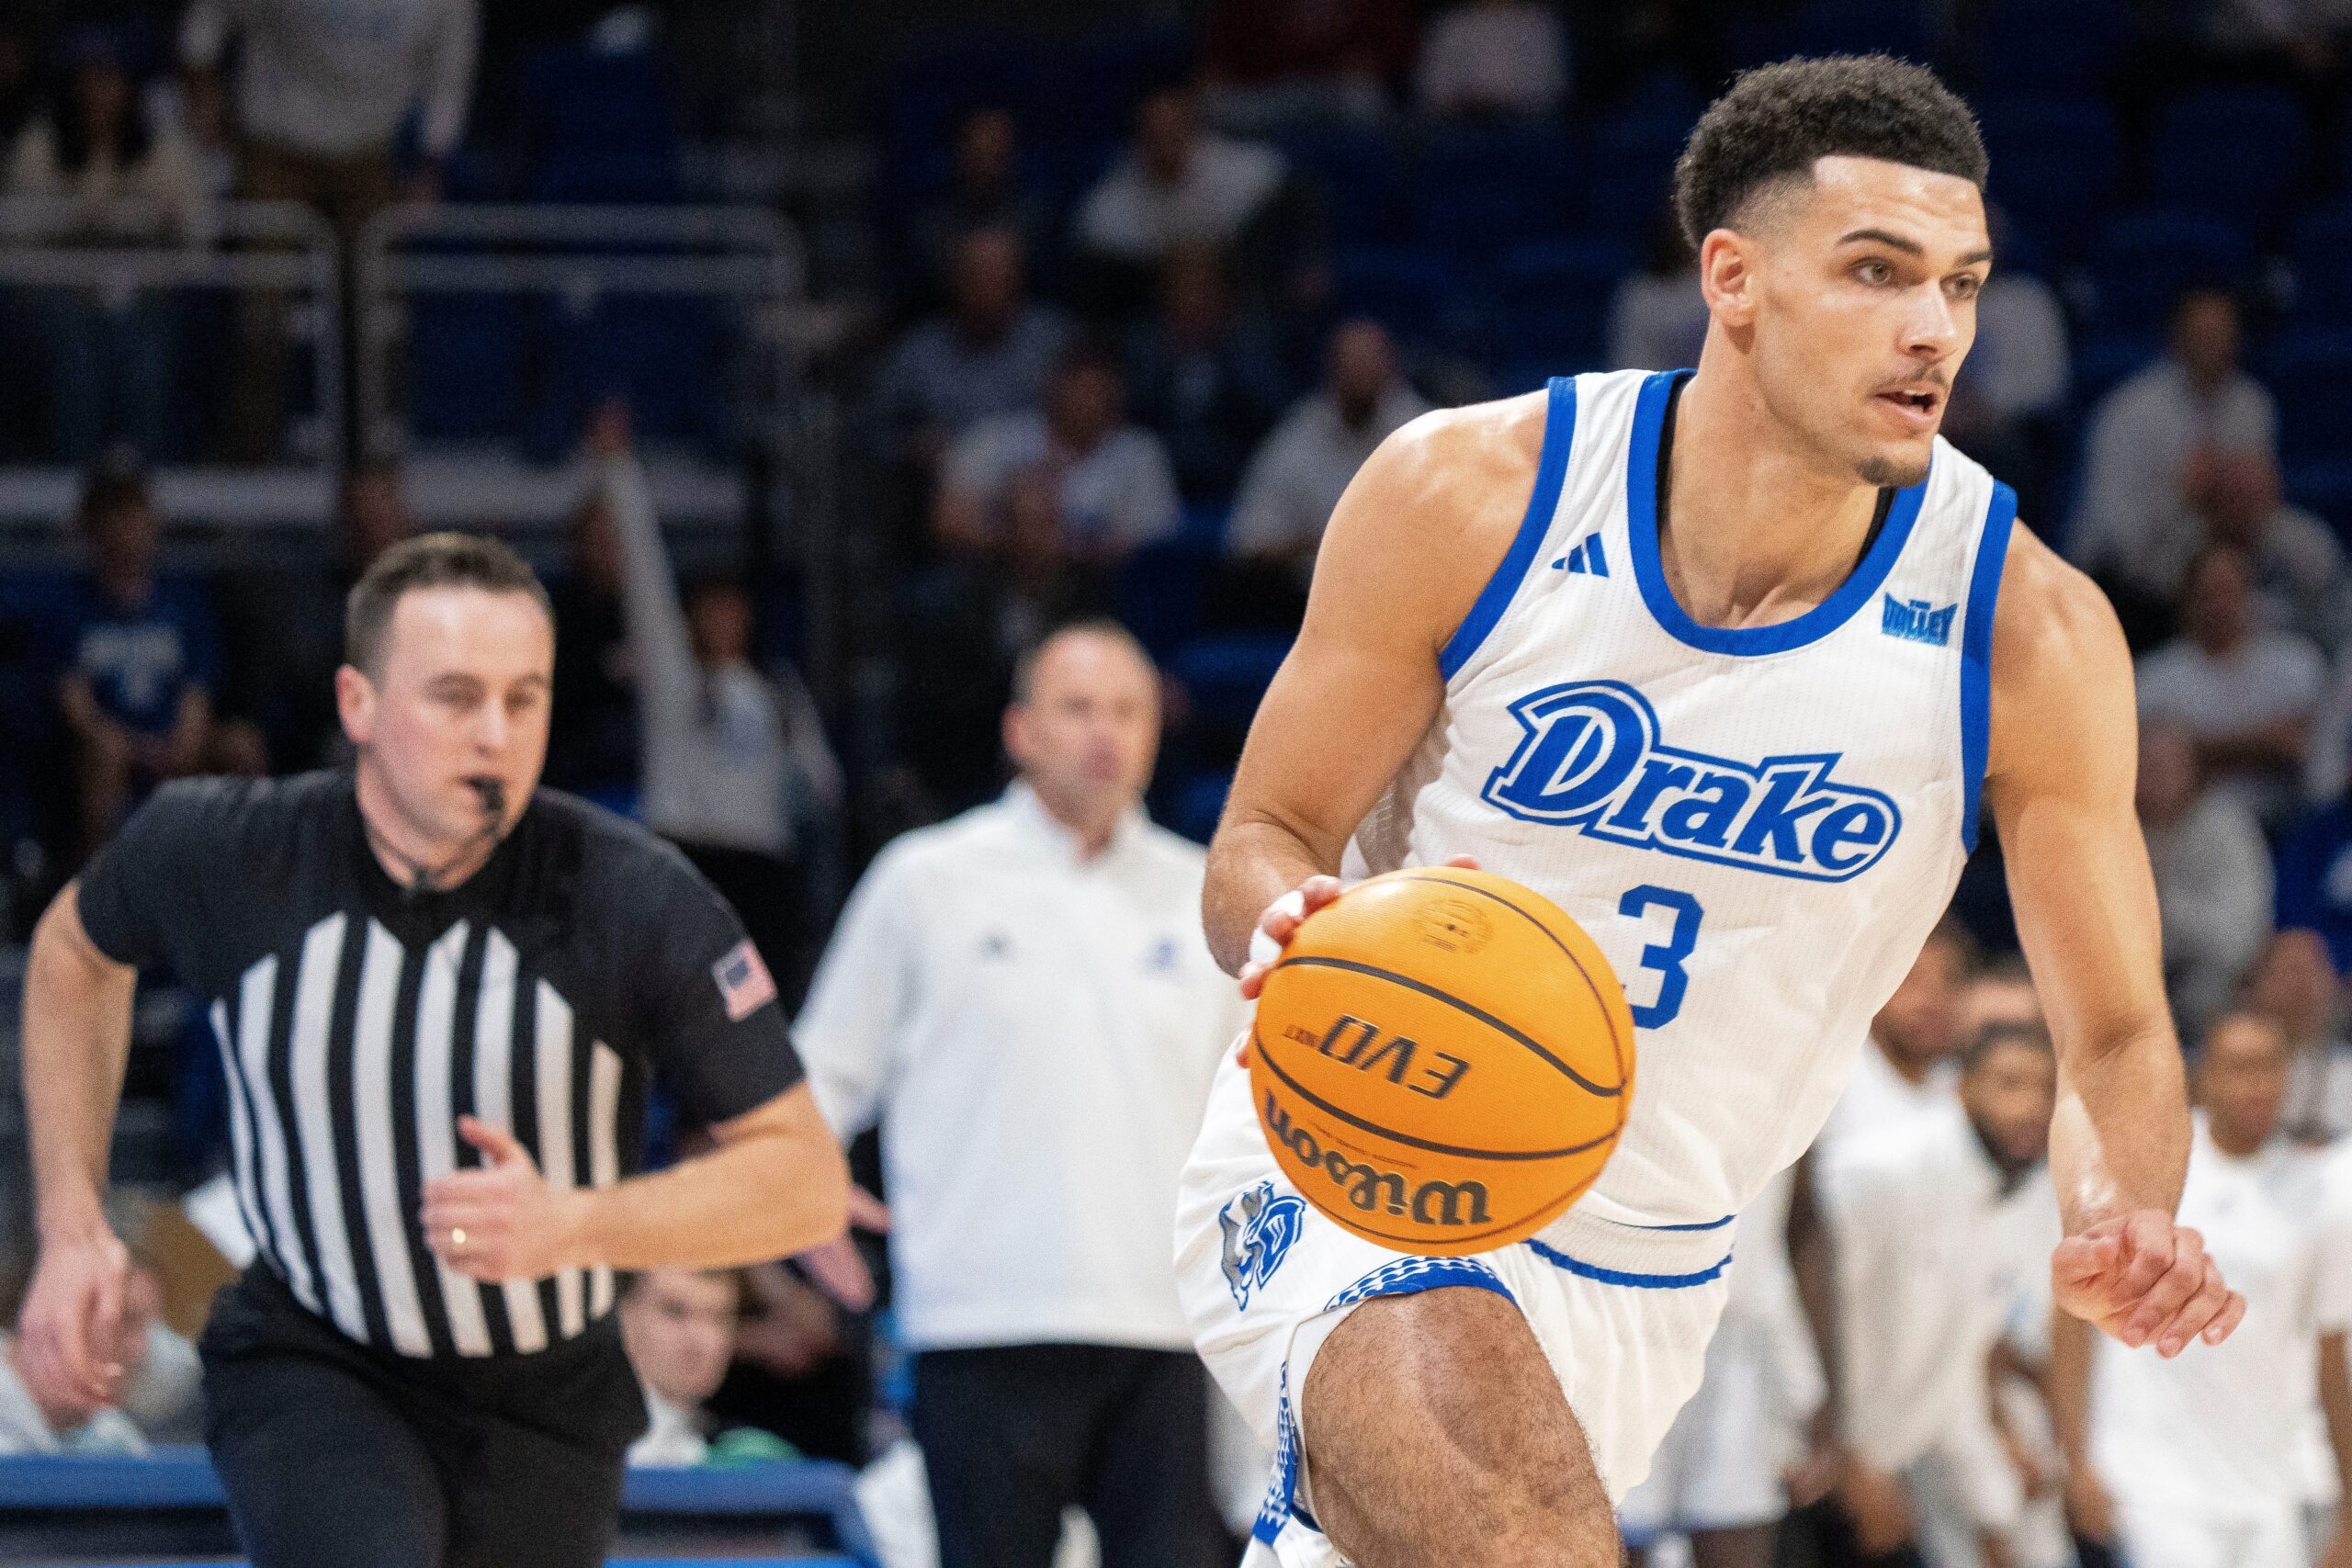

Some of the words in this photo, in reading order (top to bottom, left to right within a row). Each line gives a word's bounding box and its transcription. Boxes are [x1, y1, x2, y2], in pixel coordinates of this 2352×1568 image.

[1481, 679, 1902, 883] Drake
[1618, 884, 1704, 1030] 3
[1318, 1013, 1471, 1100] EVO
[1264, 1088, 1493, 1226] Wilson
